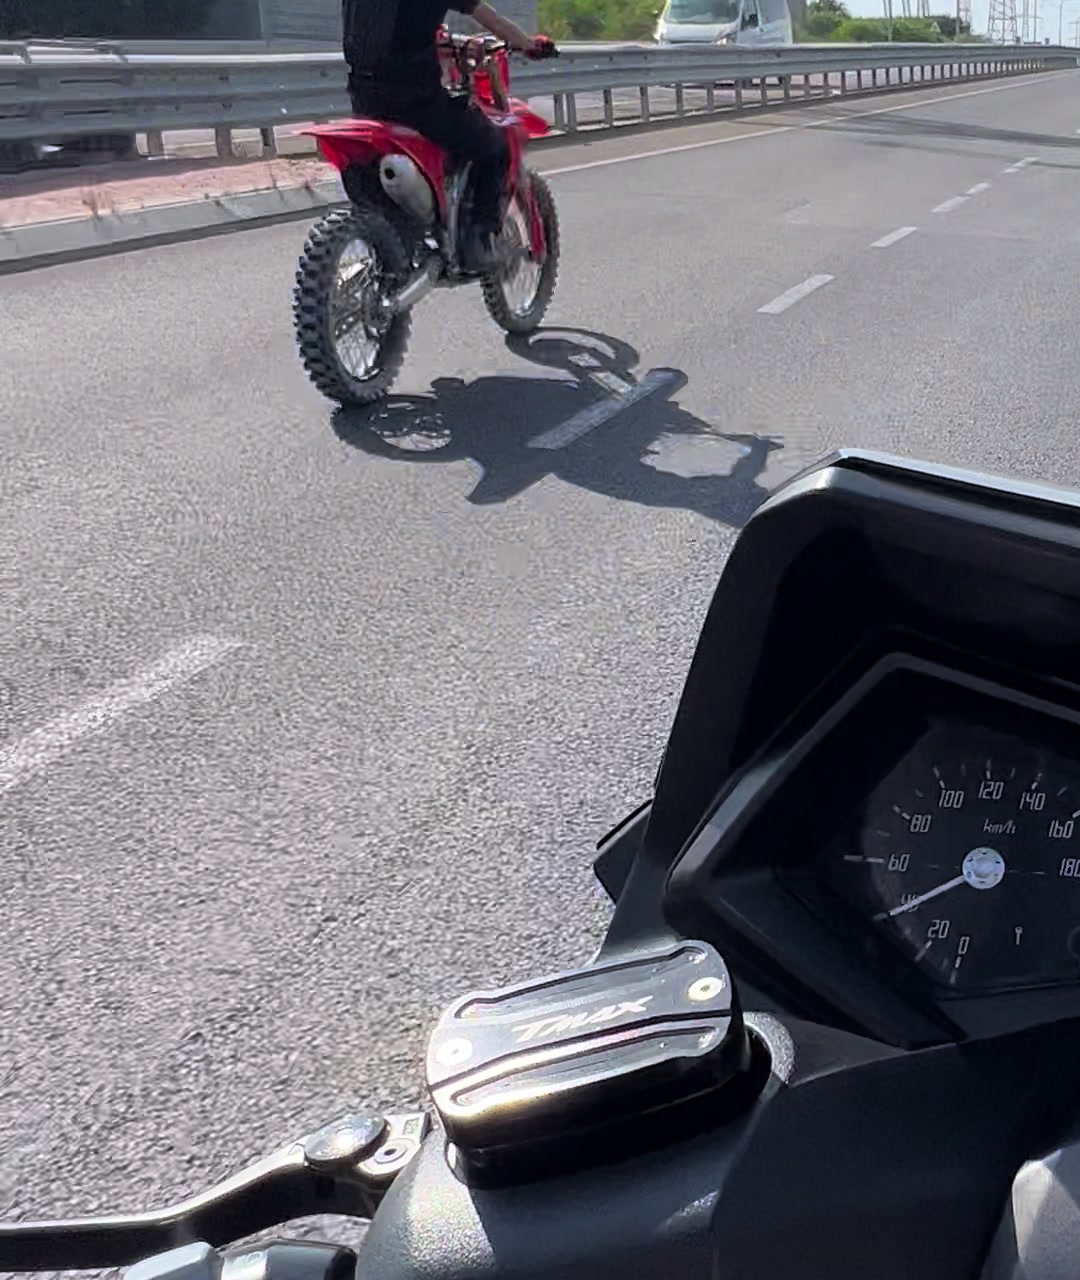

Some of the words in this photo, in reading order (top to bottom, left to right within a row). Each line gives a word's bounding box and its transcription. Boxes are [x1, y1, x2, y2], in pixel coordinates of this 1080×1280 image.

[938, 790, 964, 809] 100
[978, 781, 1005, 800] 120
[1019, 793, 1046, 811] 140
[910, 814, 932, 833] 80
[983, 819, 1016, 835] km/h
[1048, 820, 1075, 839] 160
[888, 854, 910, 872] 60
[928, 920, 950, 939] 20
[957, 936, 970, 955] 0
